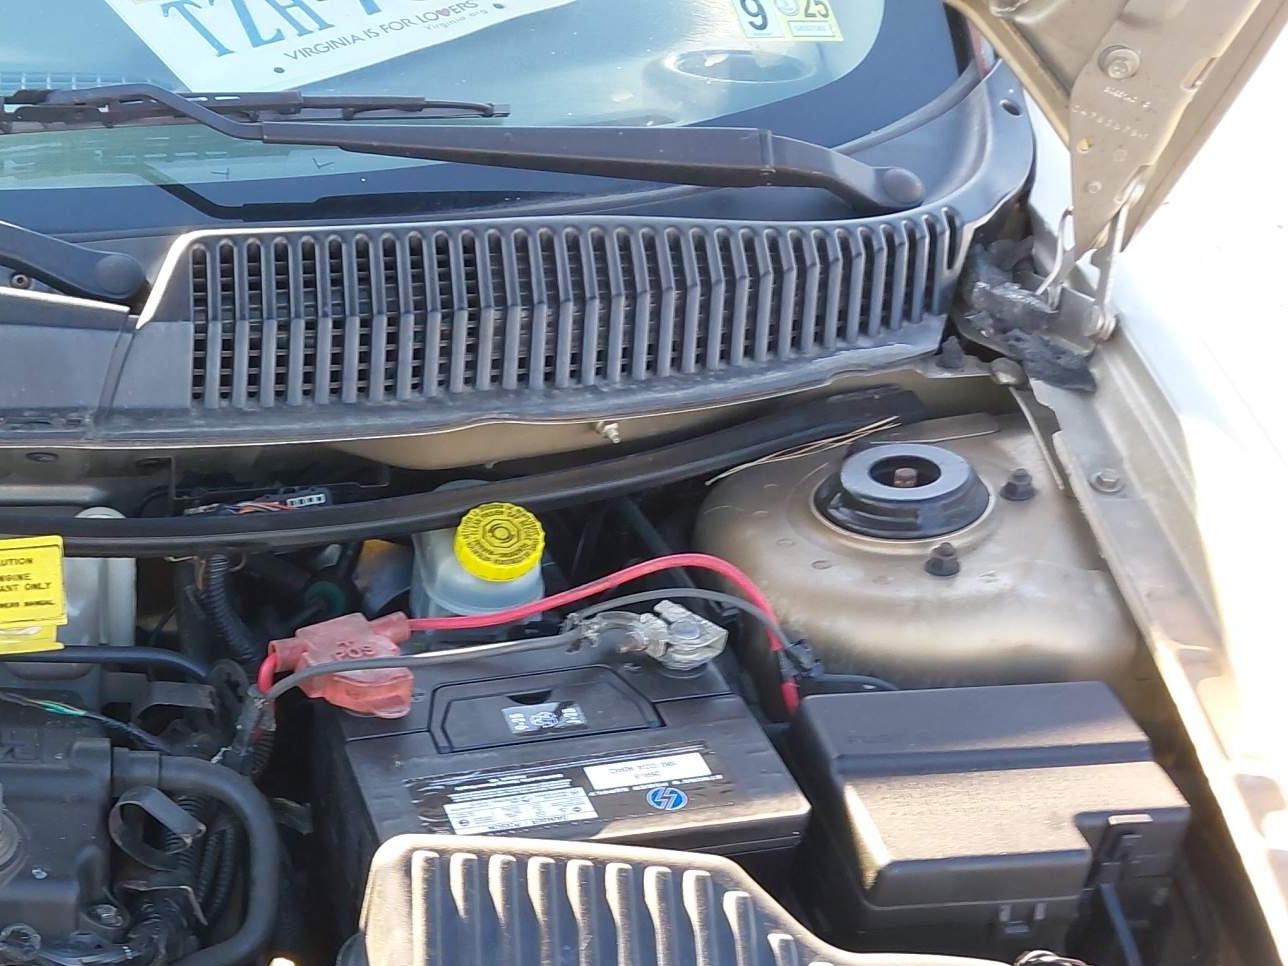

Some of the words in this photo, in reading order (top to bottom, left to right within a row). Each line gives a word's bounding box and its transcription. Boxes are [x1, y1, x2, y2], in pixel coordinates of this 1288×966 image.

[284, 34, 365, 60] VIRGINIA
[362, 27, 380, 39] IS
[379, 17, 419, 34] FOR
[24, 582, 52, 591] ONLY
